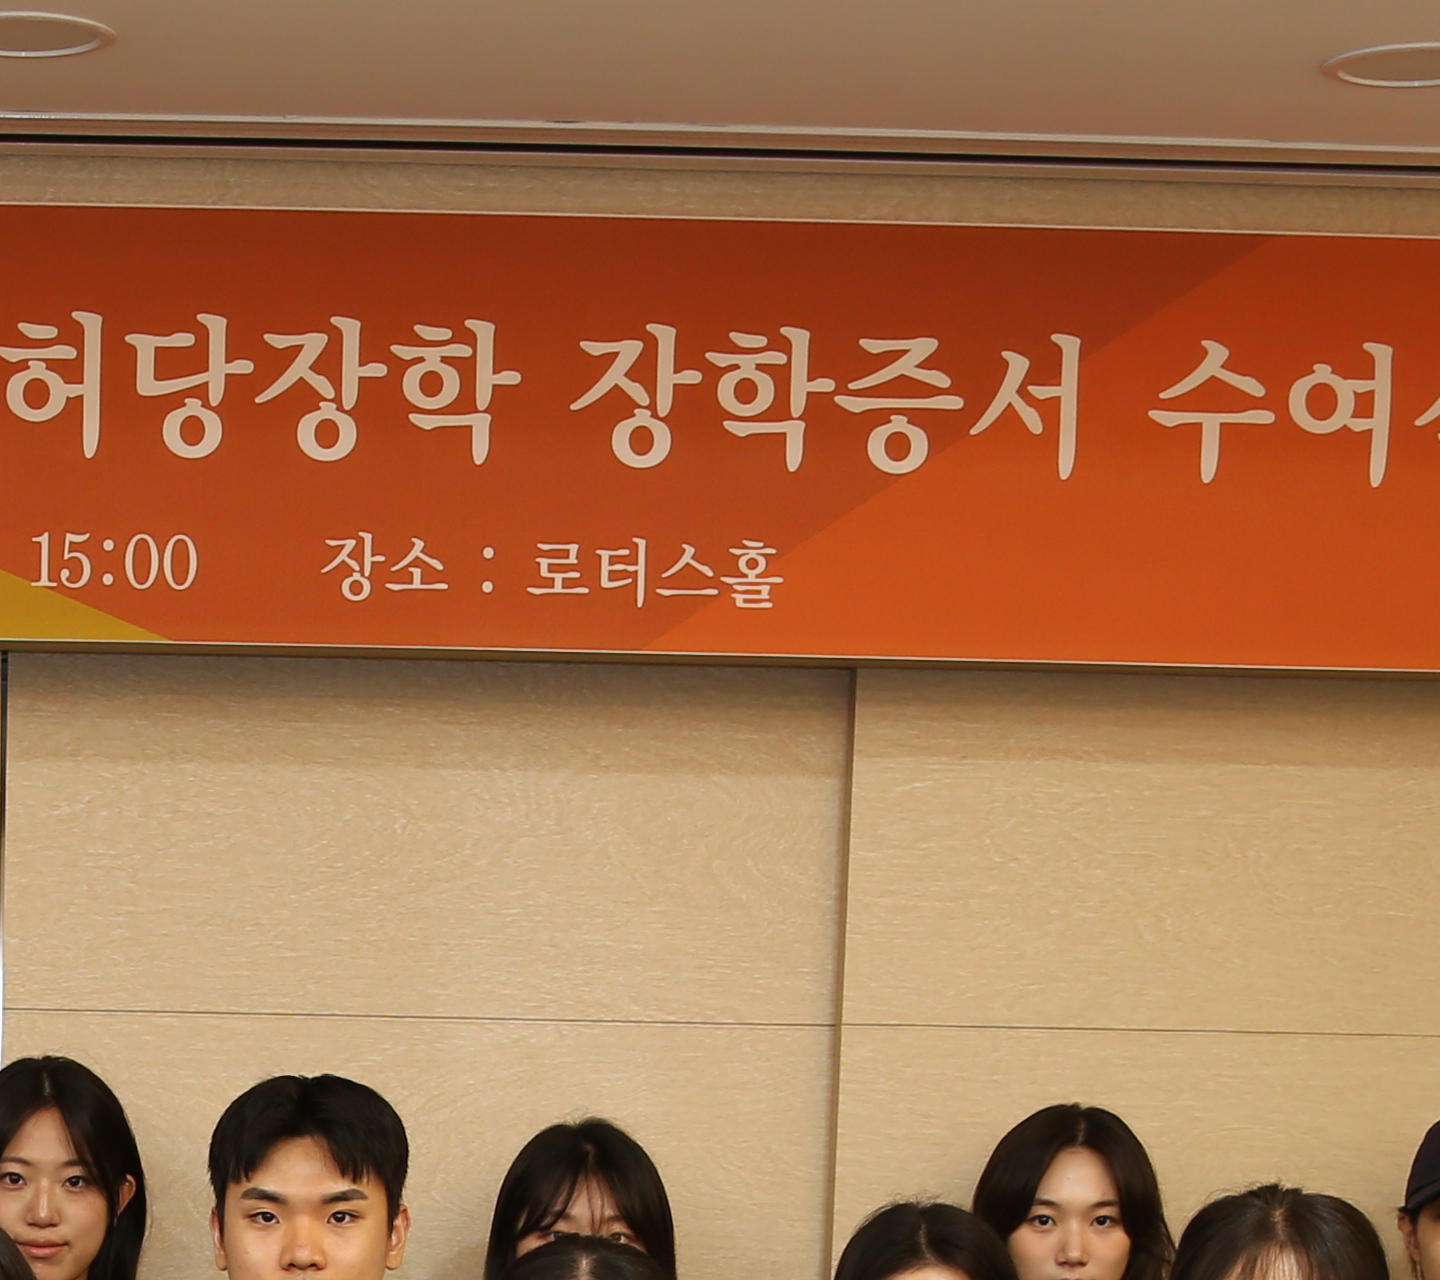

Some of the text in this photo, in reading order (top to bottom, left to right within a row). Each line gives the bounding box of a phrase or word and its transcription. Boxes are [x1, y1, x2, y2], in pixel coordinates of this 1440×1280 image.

[570, 324, 1080, 480] 장학증서
[31, 532, 197, 589] 15:00
[321, 532, 783, 607] 장소 : 로터스홀
